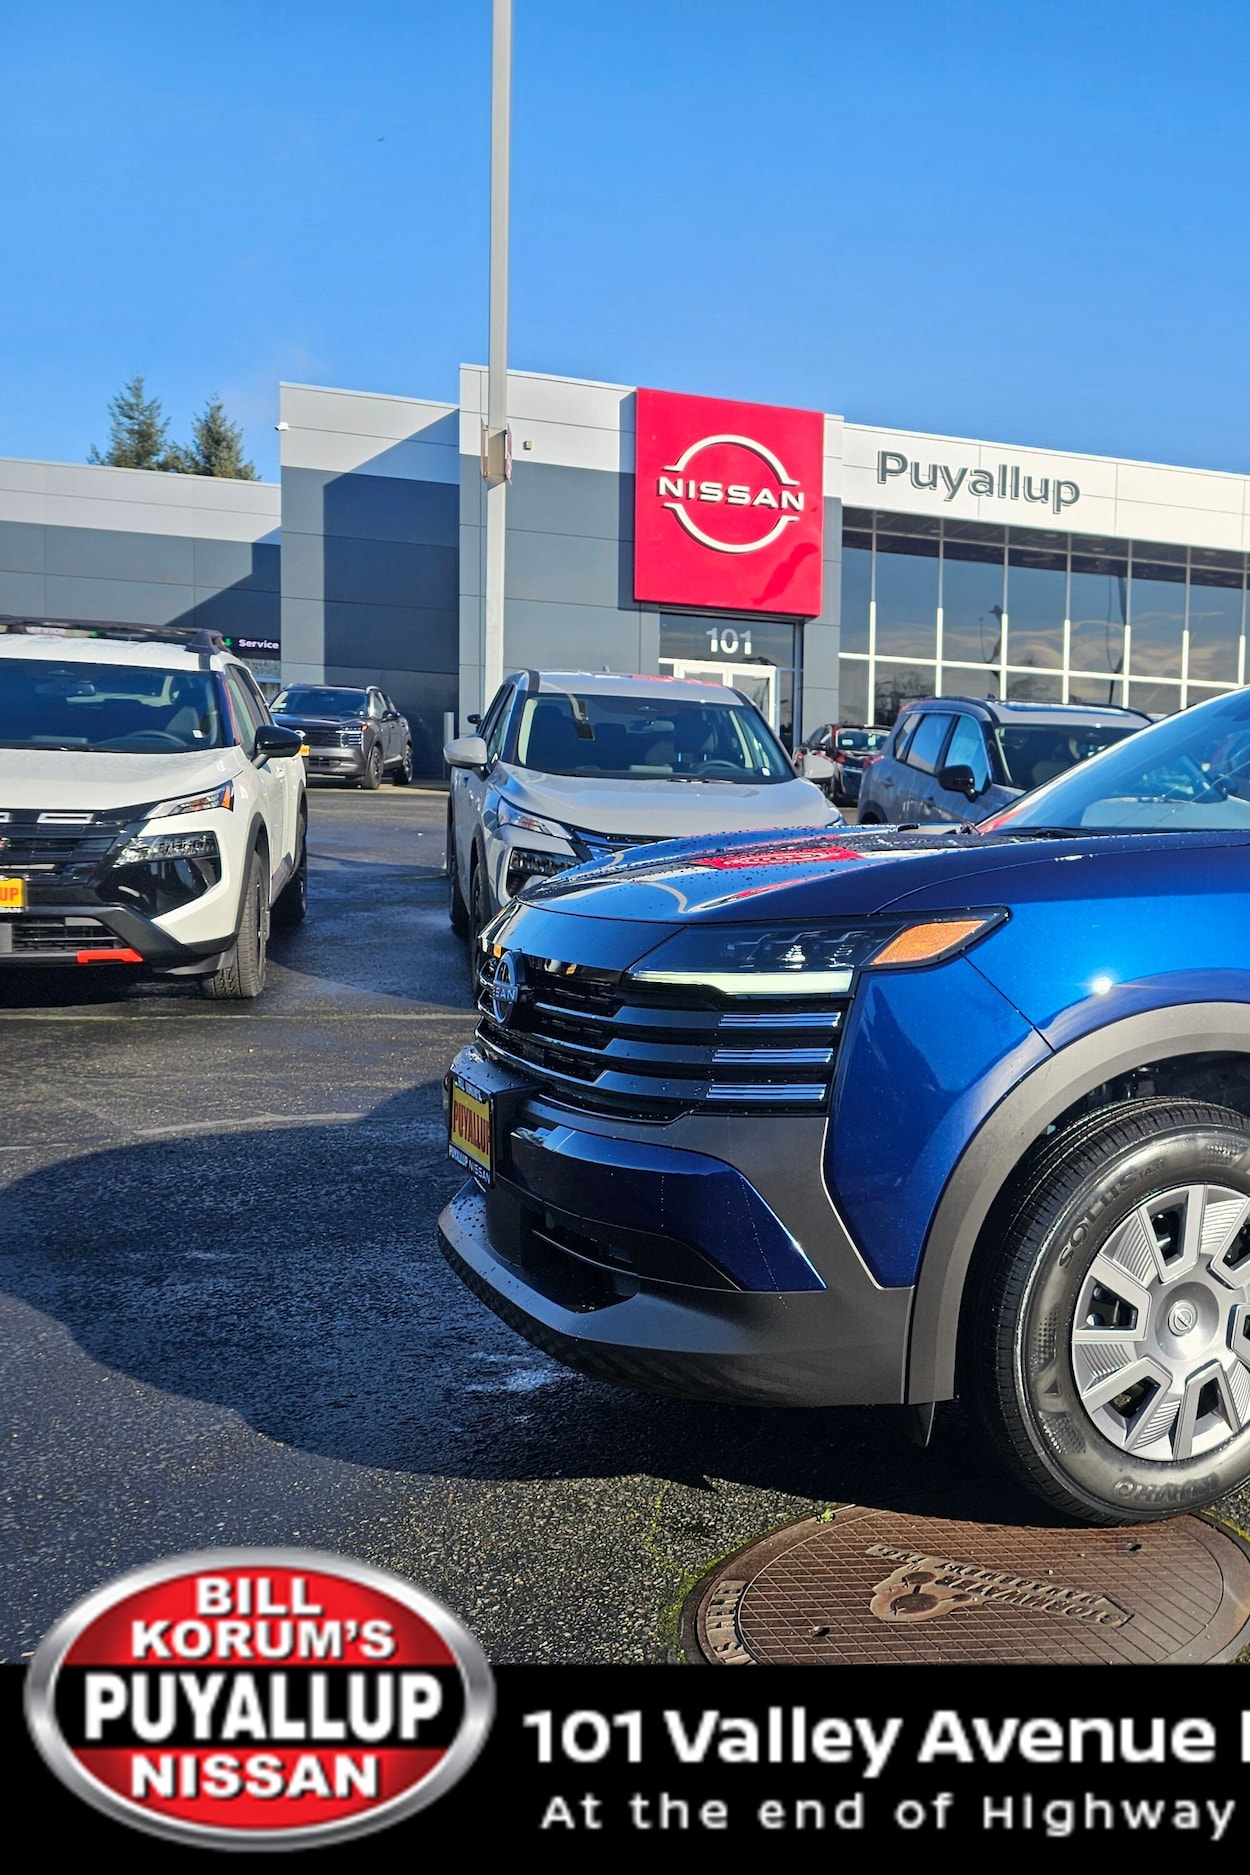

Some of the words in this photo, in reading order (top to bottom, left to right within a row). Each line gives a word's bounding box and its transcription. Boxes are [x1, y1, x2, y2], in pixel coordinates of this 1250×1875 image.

[658, 476, 805, 511] NISSAN
[877, 450, 1080, 514] Puyallup
[238, 639, 279, 649] Service
[706, 627, 752, 655] 101
[453, 1100, 491, 1155] PUYALLUP
[1059, 1170, 1137, 1268] SOLUS
